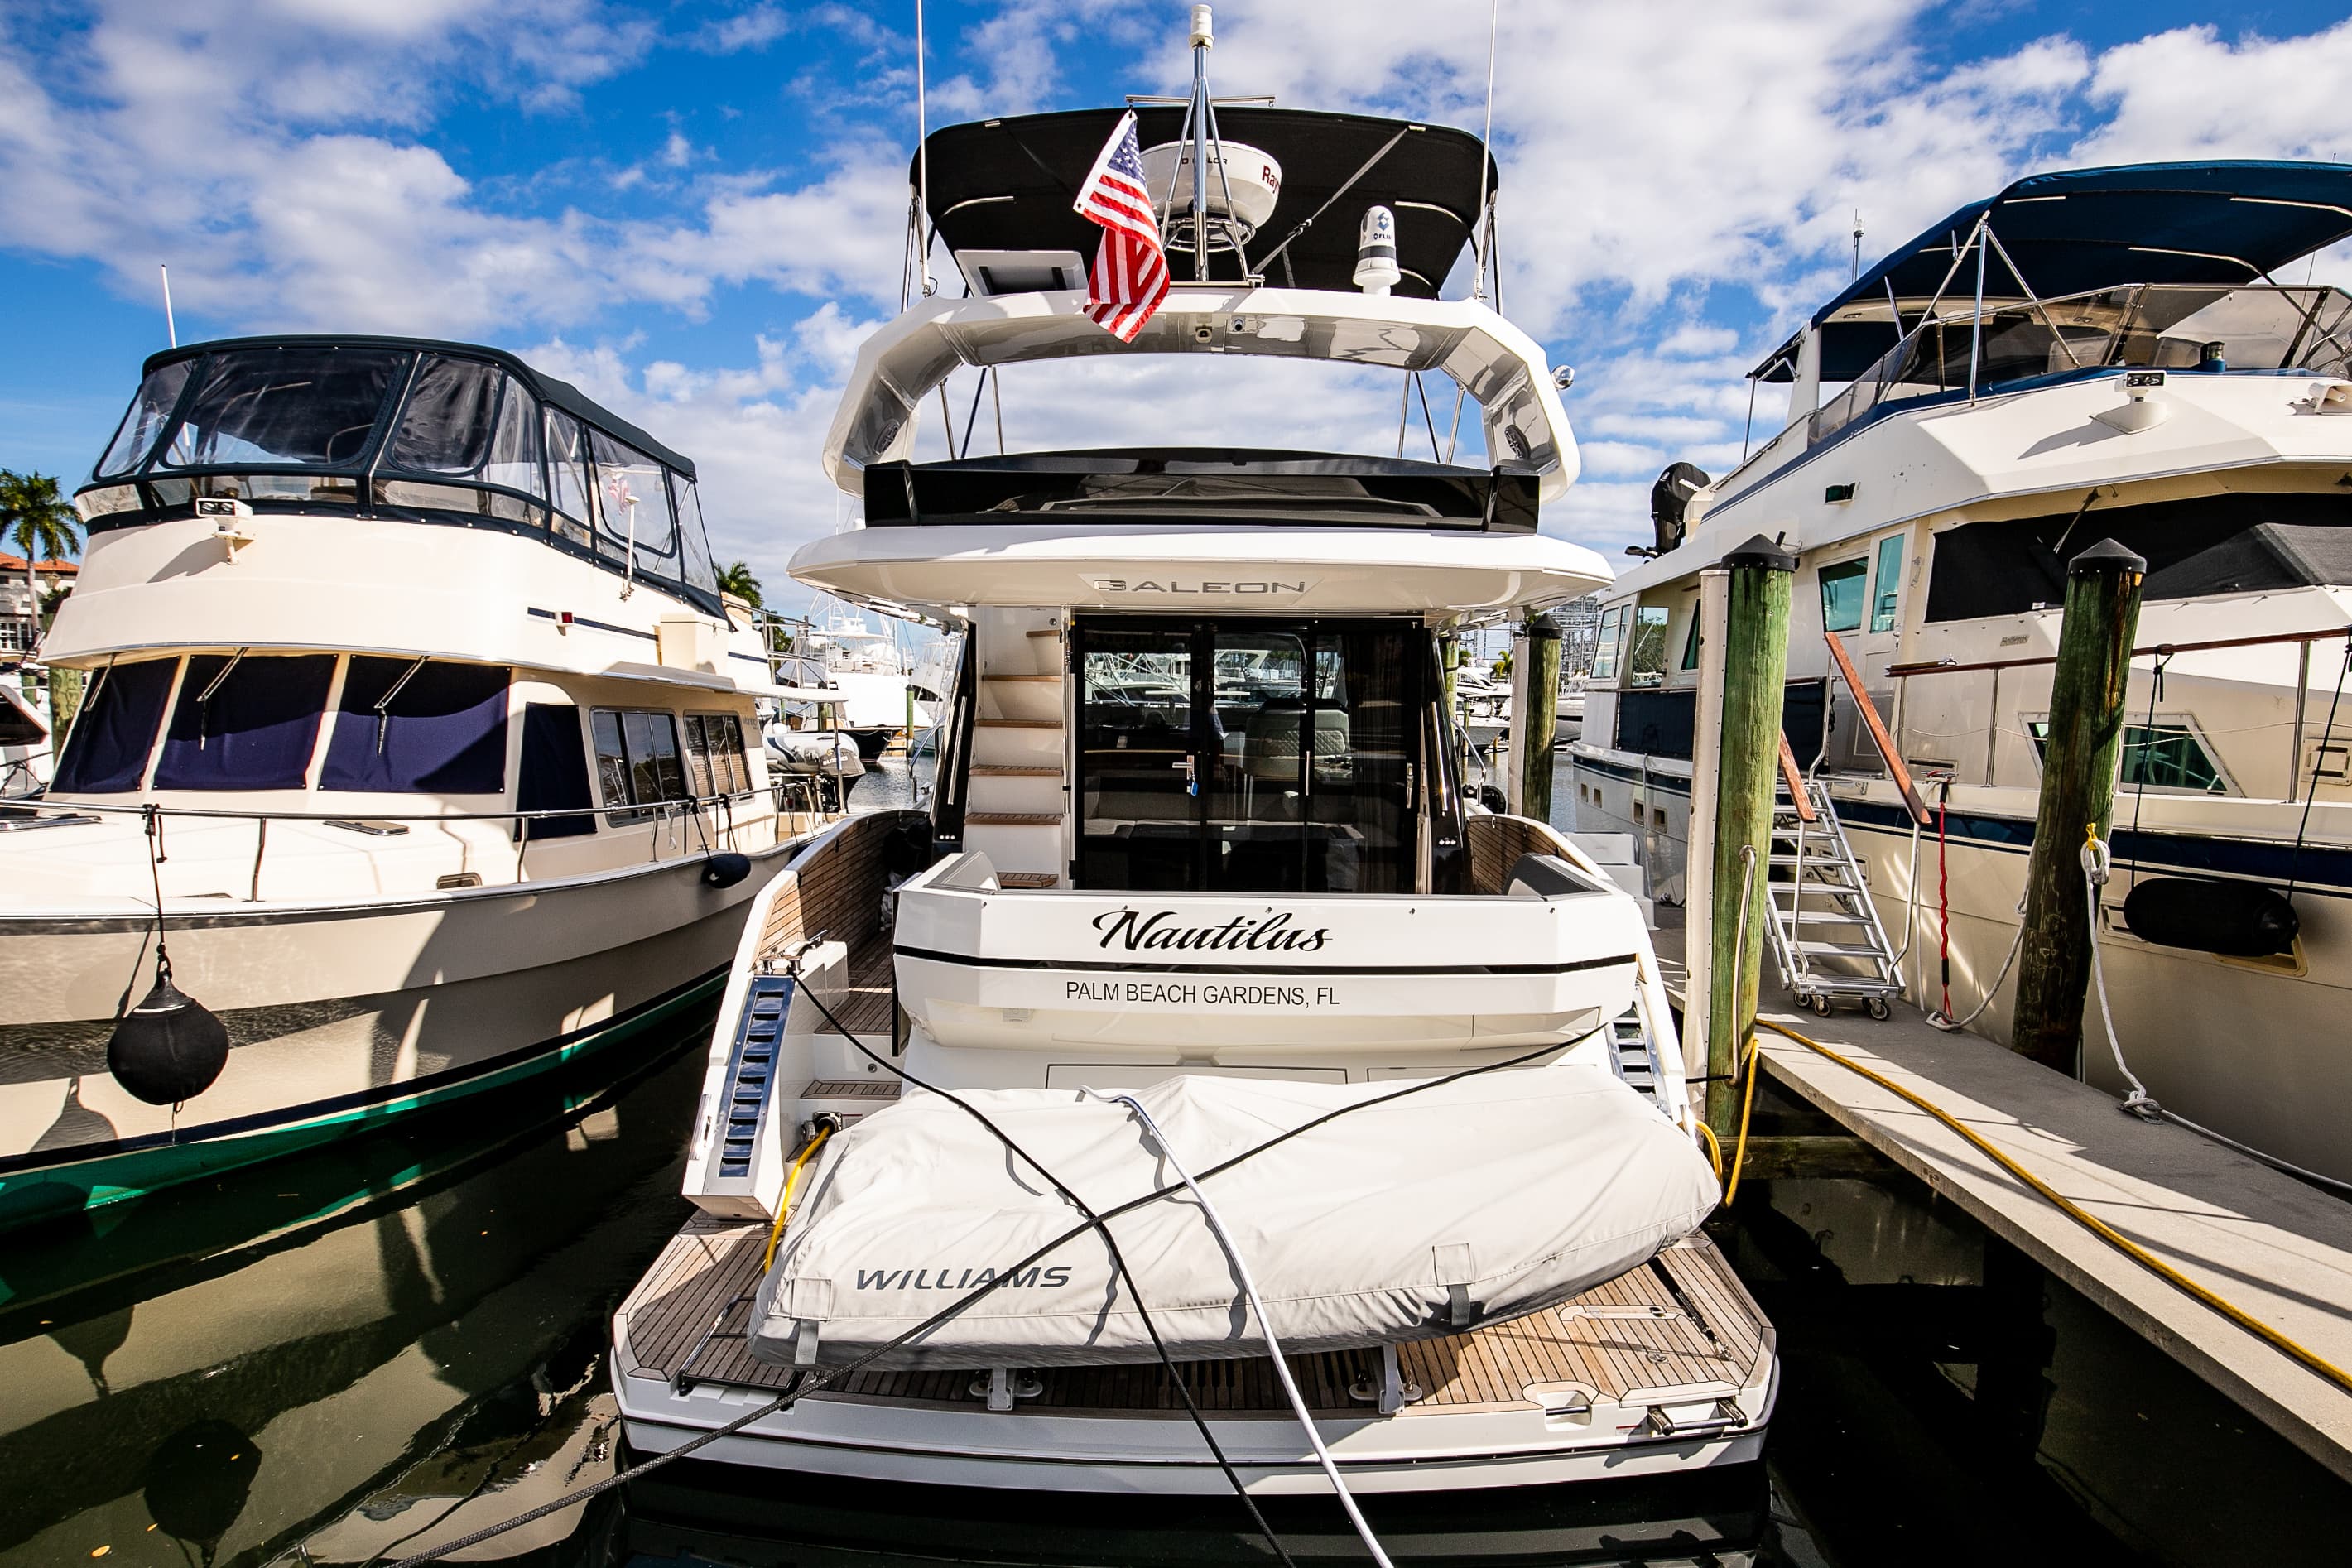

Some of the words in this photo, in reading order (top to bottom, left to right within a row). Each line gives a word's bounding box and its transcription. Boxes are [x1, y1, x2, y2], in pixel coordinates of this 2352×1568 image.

[1262, 165, 1280, 194] Ray
[1093, 580, 1306, 594] GALEON
[1091, 911, 1333, 951] Nautilus
[1066, 981, 1119, 1001] PALM
[1126, 984, 1196, 1003] BEACH
[1203, 985, 1310, 1008] GARDENS,
[1317, 987, 1340, 1005] FL
[856, 1267, 1072, 1291] WILLIAMS
